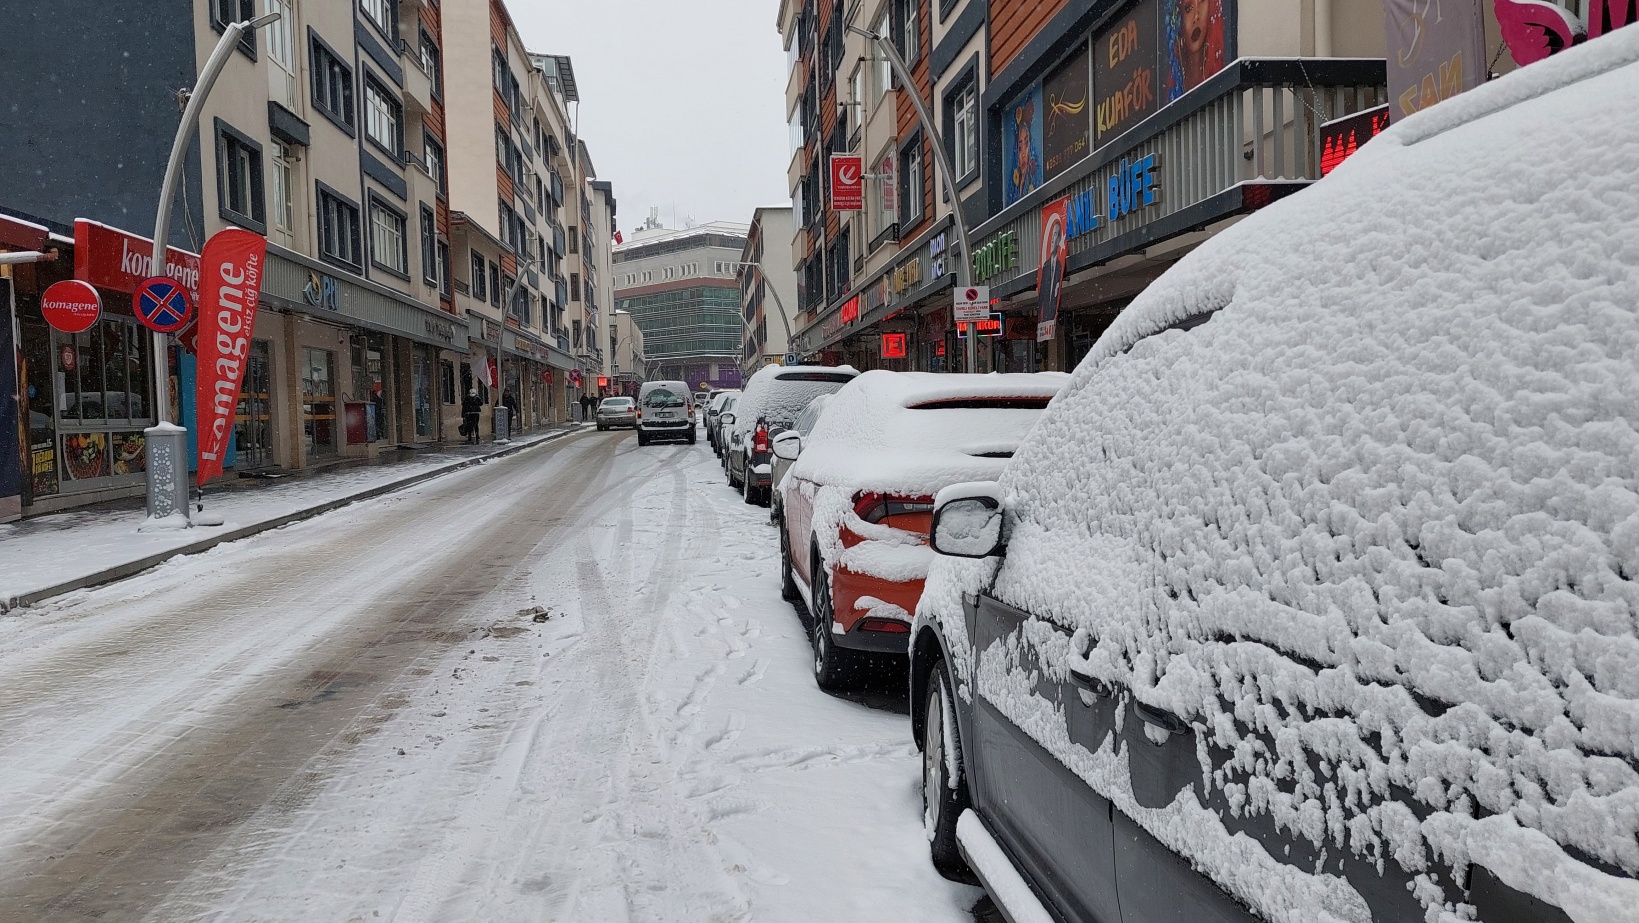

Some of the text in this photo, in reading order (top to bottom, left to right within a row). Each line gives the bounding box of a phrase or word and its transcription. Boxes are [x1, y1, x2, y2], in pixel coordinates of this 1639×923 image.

[1110, 20, 1137, 69] EDA
[1097, 66, 1153, 139] KUAFÖR
[1066, 154, 1155, 241] ANIL BÜFE
[245, 253, 259, 286] köfte
[43, 298, 98, 312] komagene
